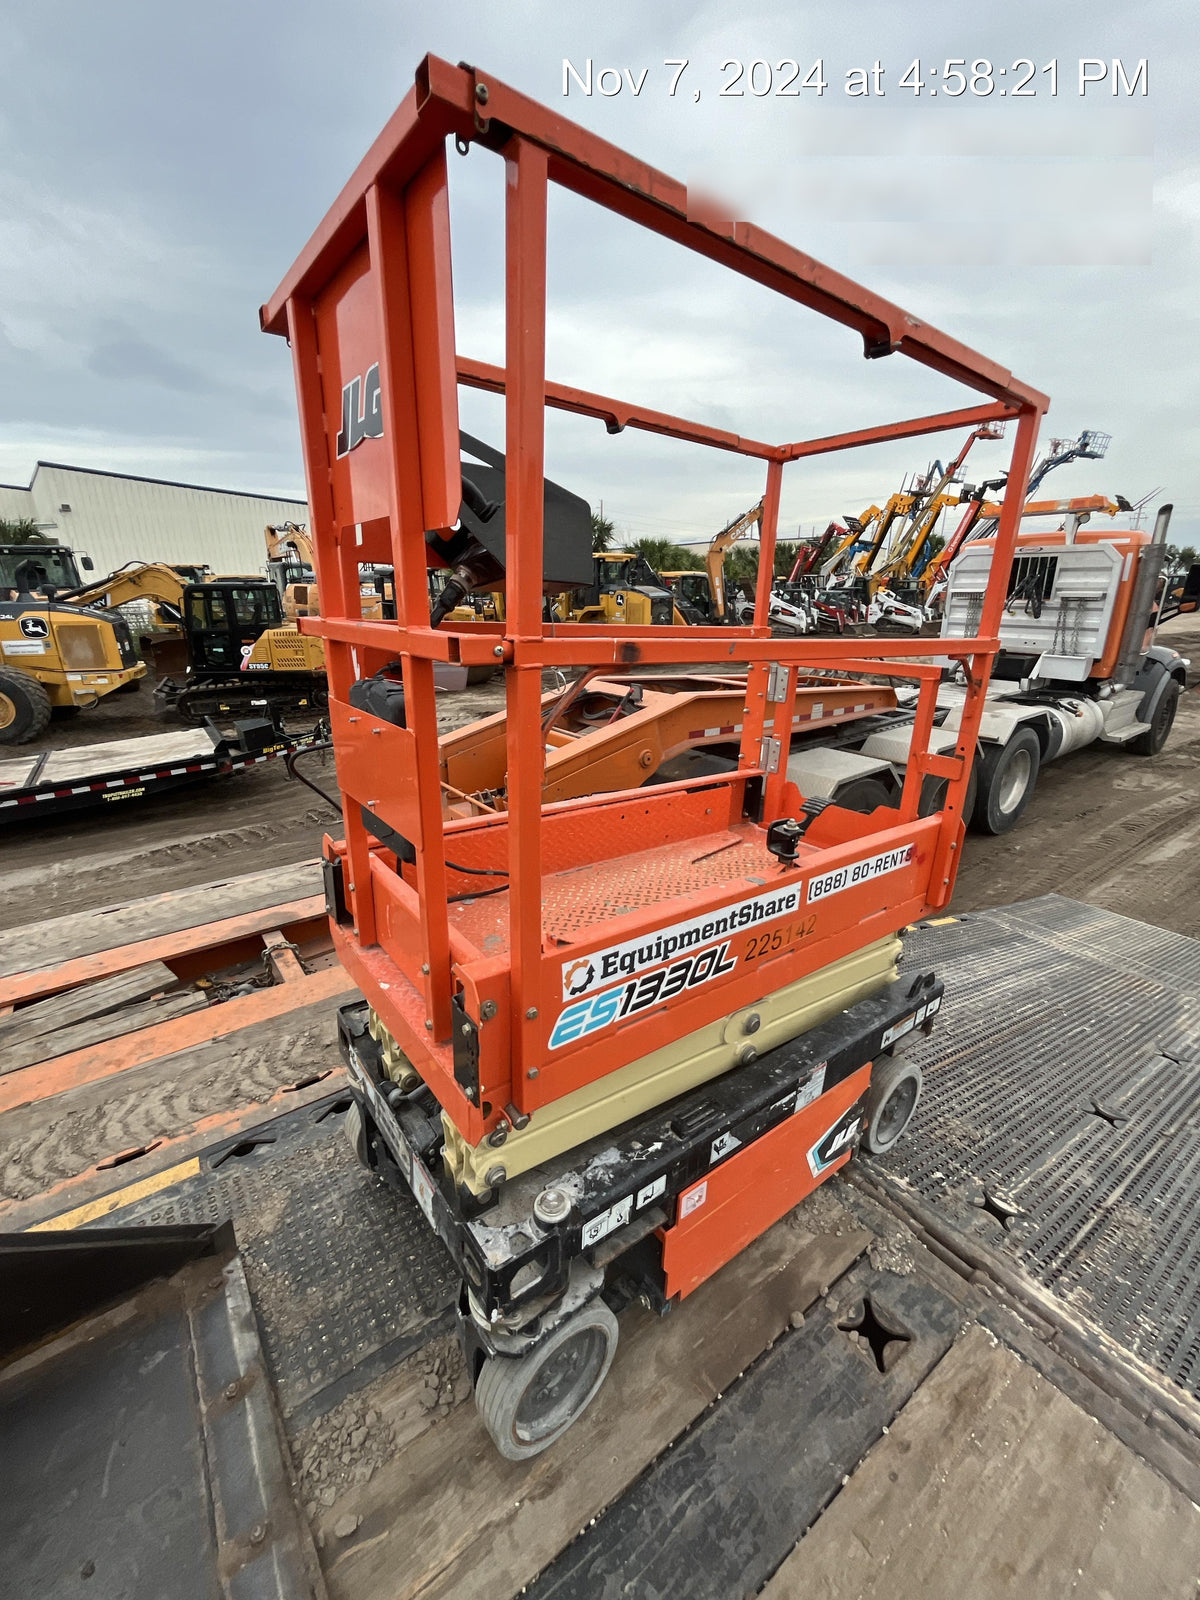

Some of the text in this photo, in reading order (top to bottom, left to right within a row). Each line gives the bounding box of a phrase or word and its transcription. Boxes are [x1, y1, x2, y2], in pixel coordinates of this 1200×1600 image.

[336, 361, 384, 460] JLG
[808, 847, 913, 900] (888) 80-RENTS
[601, 890, 797, 980] EquipmentShare
[744, 914, 818, 963] 225142
[549, 942, 736, 1048] ES1330L
[824, 1117, 861, 1159] JLG
